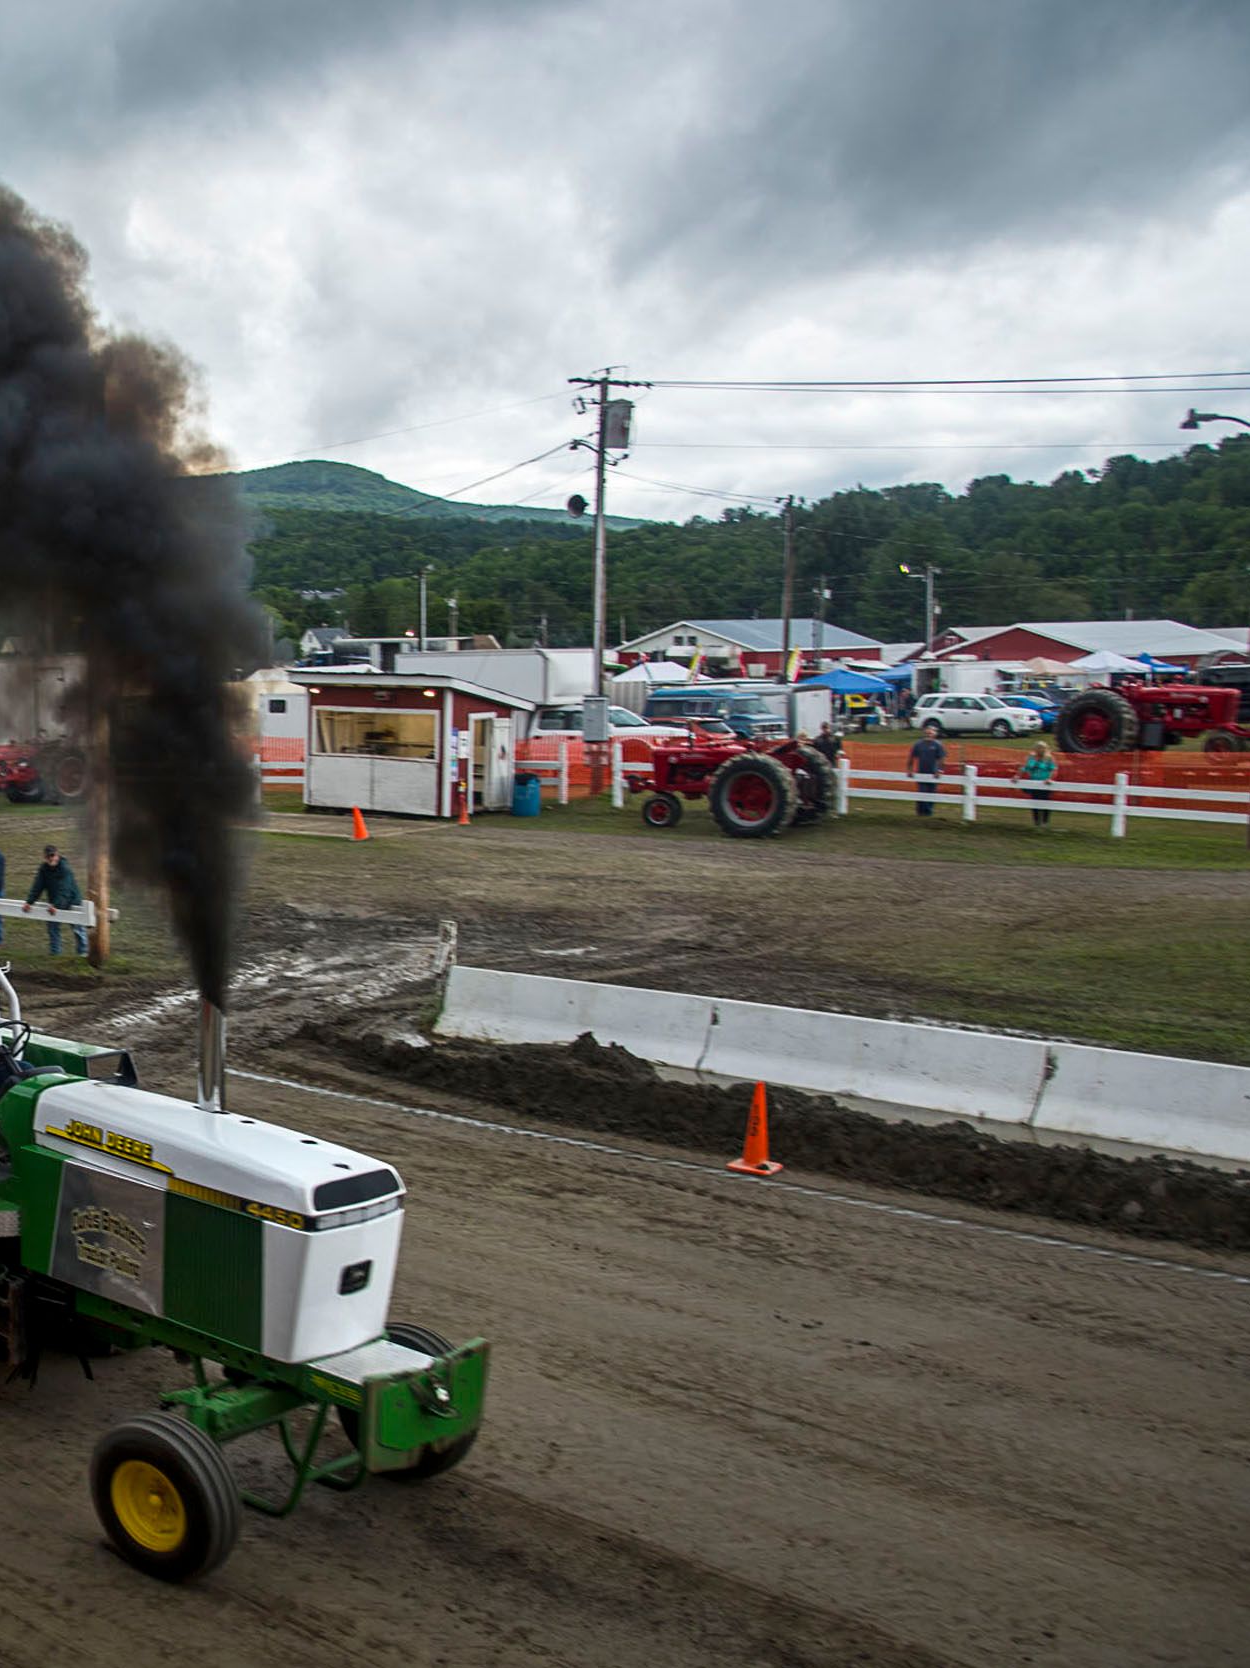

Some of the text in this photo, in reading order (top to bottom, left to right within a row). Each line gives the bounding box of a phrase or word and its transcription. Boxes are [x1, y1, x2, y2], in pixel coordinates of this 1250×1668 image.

[65, 1119, 153, 1160] JOHN DEERE
[245, 1201, 305, 1230] 4450
